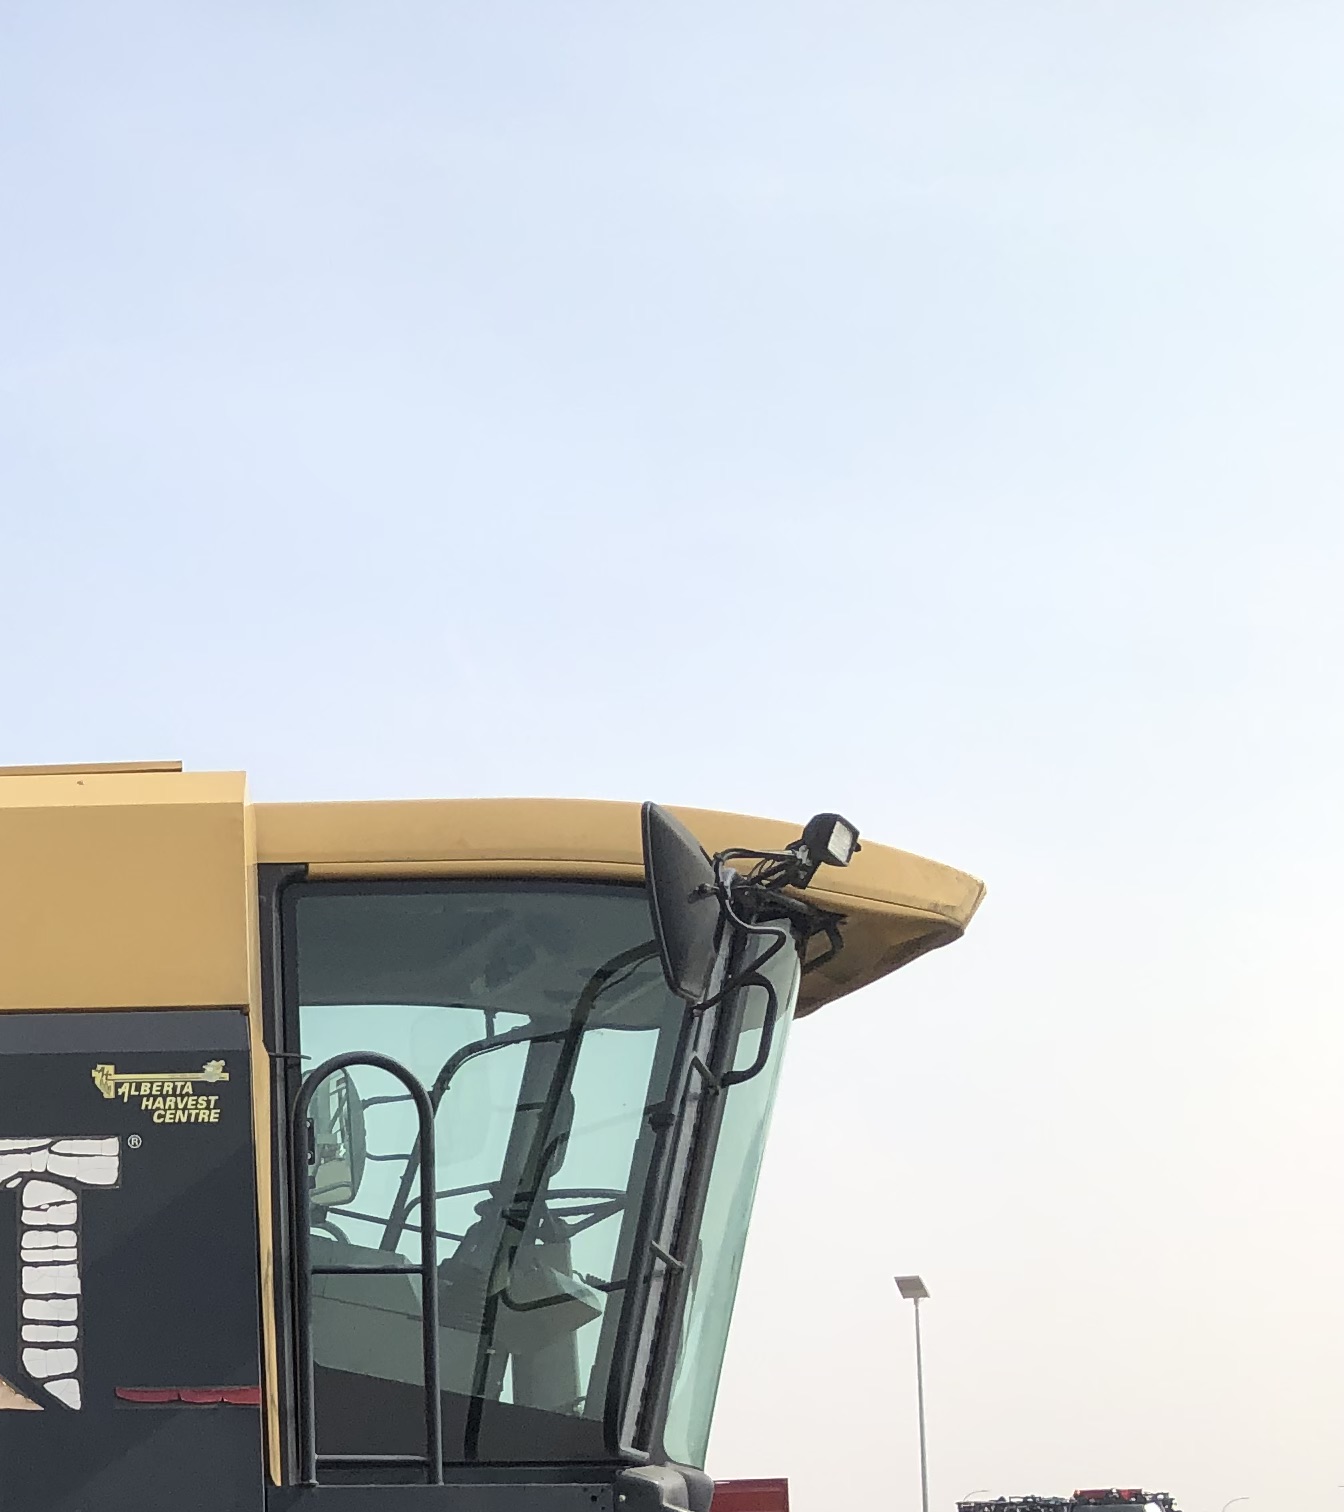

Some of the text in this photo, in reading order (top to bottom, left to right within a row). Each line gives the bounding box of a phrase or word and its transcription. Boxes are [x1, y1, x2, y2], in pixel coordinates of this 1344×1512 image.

[118, 1082, 193, 1102] ALBERTA
[141, 1096, 218, 1110] HARVEST
[153, 1109, 220, 1123] CENTRE
